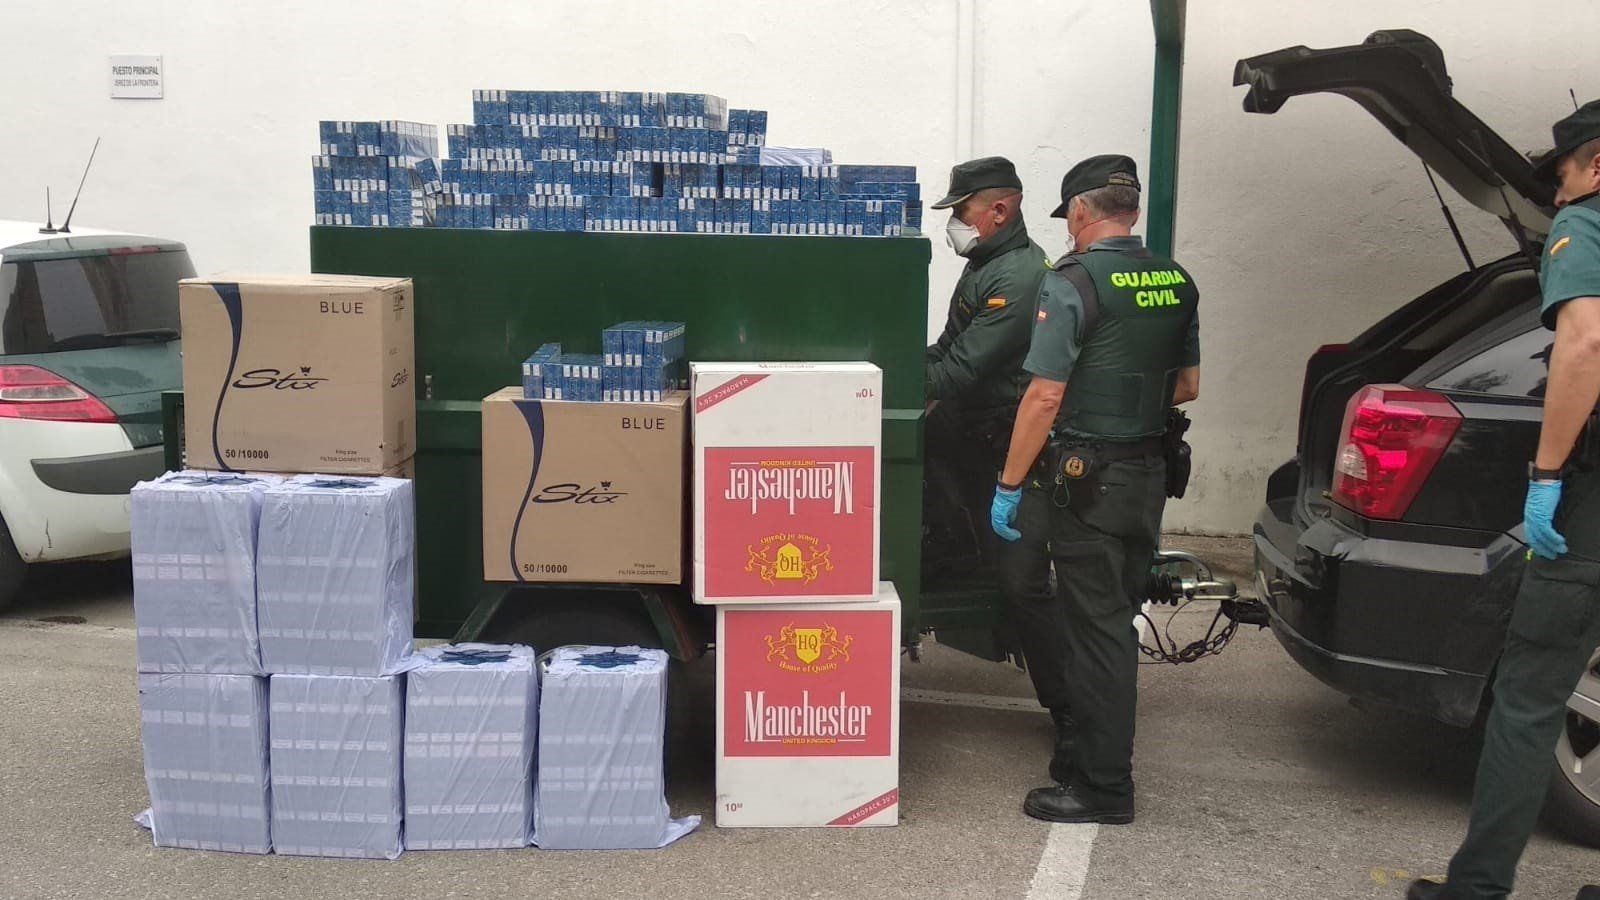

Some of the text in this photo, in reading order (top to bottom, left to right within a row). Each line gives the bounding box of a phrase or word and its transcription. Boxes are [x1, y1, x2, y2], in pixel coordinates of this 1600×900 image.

[112, 65, 159, 75] PUESTO PRINCIPAL
[1111, 270, 1186, 288] GUARDIA
[319, 301, 364, 314] BLUE
[1136, 289, 1181, 308] CIVIL
[232, 368, 329, 390] Stix
[714, 377, 749, 399] HARDPACK
[622, 417, 665, 430] BLUE
[792, 460, 816, 468] UNITED
[532, 483, 629, 504] Stix
[724, 461, 855, 515] Manchester
[780, 552, 799, 572] HQ
[798, 634, 819, 653] HQ
[779, 660, 801, 672] House
[811, 661, 838, 674] Quality
[744, 690, 873, 743] Manchester
[847, 801, 882, 823] HARDPACK
